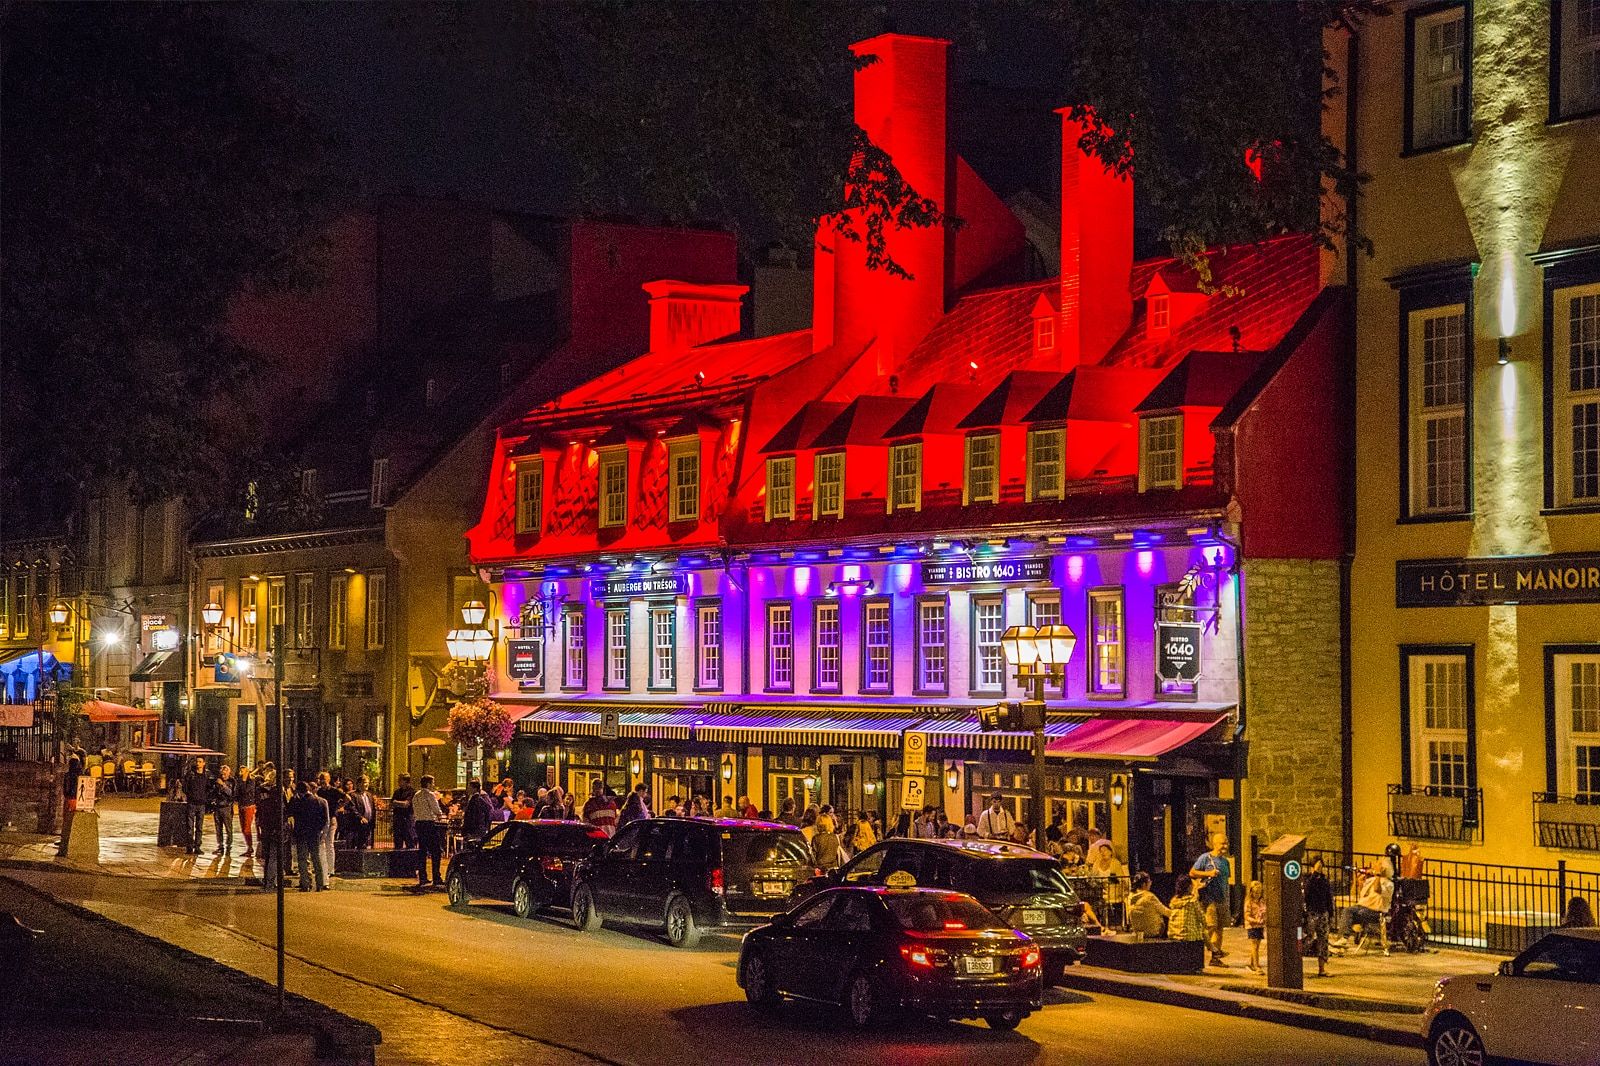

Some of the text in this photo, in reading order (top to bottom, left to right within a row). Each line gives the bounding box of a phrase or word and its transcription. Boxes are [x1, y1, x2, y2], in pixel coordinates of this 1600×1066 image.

[955, 564, 1015, 579] BISTRO 1640
[613, 578, 677, 593] AUBERGE DU TRÉSOR
[1421, 567, 1600, 592] HÔTEL MANOIR
[1164, 642, 1194, 656] 1640
